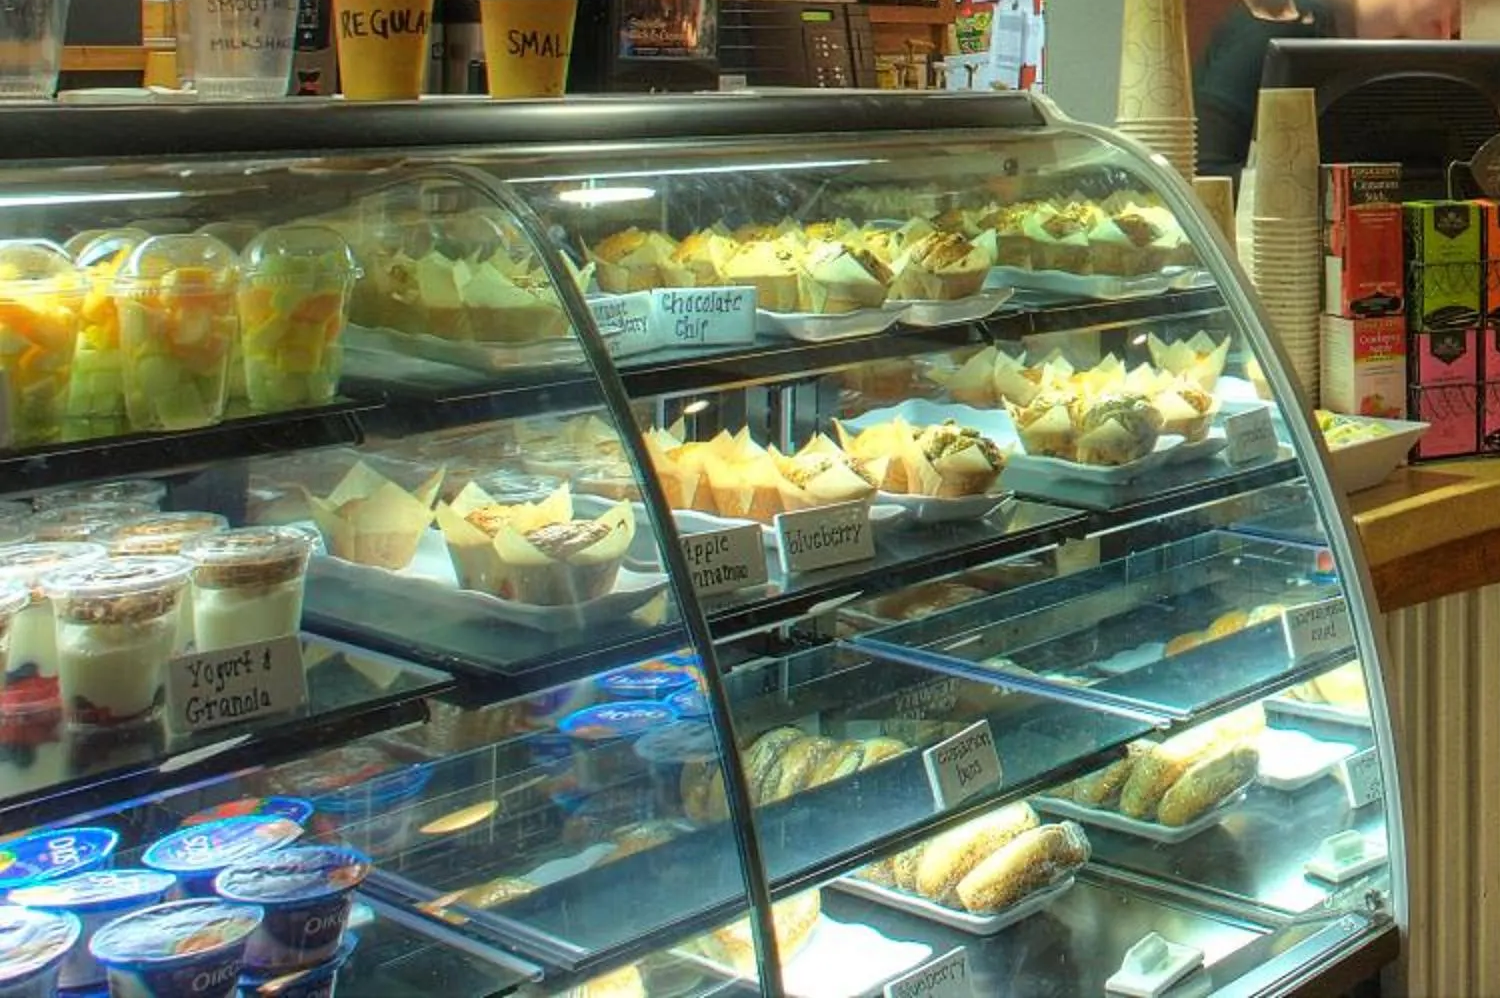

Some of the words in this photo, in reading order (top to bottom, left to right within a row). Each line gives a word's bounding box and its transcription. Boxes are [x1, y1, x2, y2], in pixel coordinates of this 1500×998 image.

[340, 8, 430, 40] REGULA
[507, 28, 570, 59] SMAL
[185, 649, 255, 693] Yogurt
[185, 686, 273, 725] Granola
